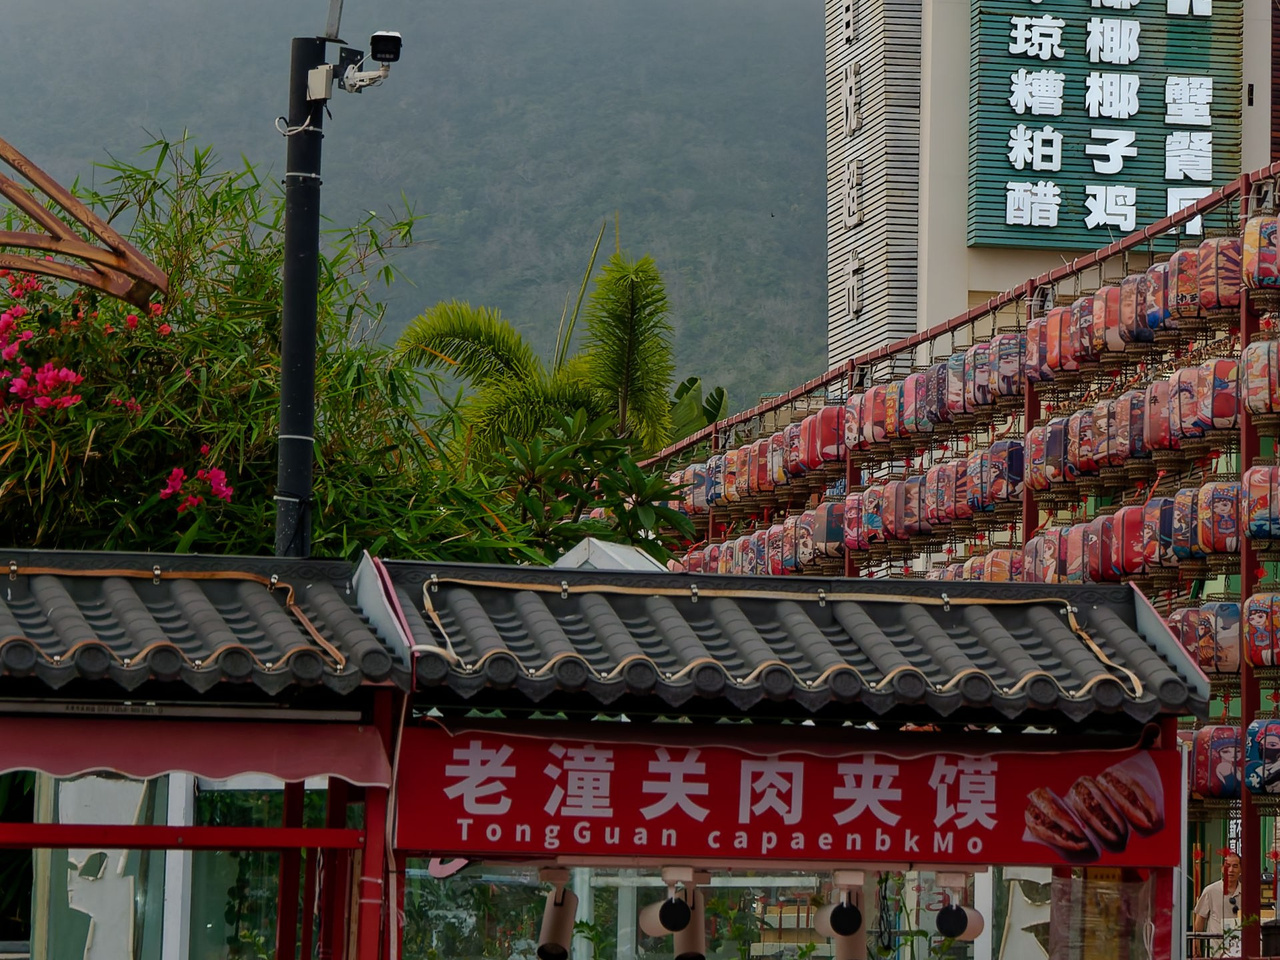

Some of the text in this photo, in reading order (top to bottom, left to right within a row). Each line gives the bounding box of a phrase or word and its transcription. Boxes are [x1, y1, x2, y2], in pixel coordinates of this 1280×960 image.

[444, 740, 999, 831] 老潼关肉夹馍
[456, 817, 985, 856] TongGuan capaenbkMo
